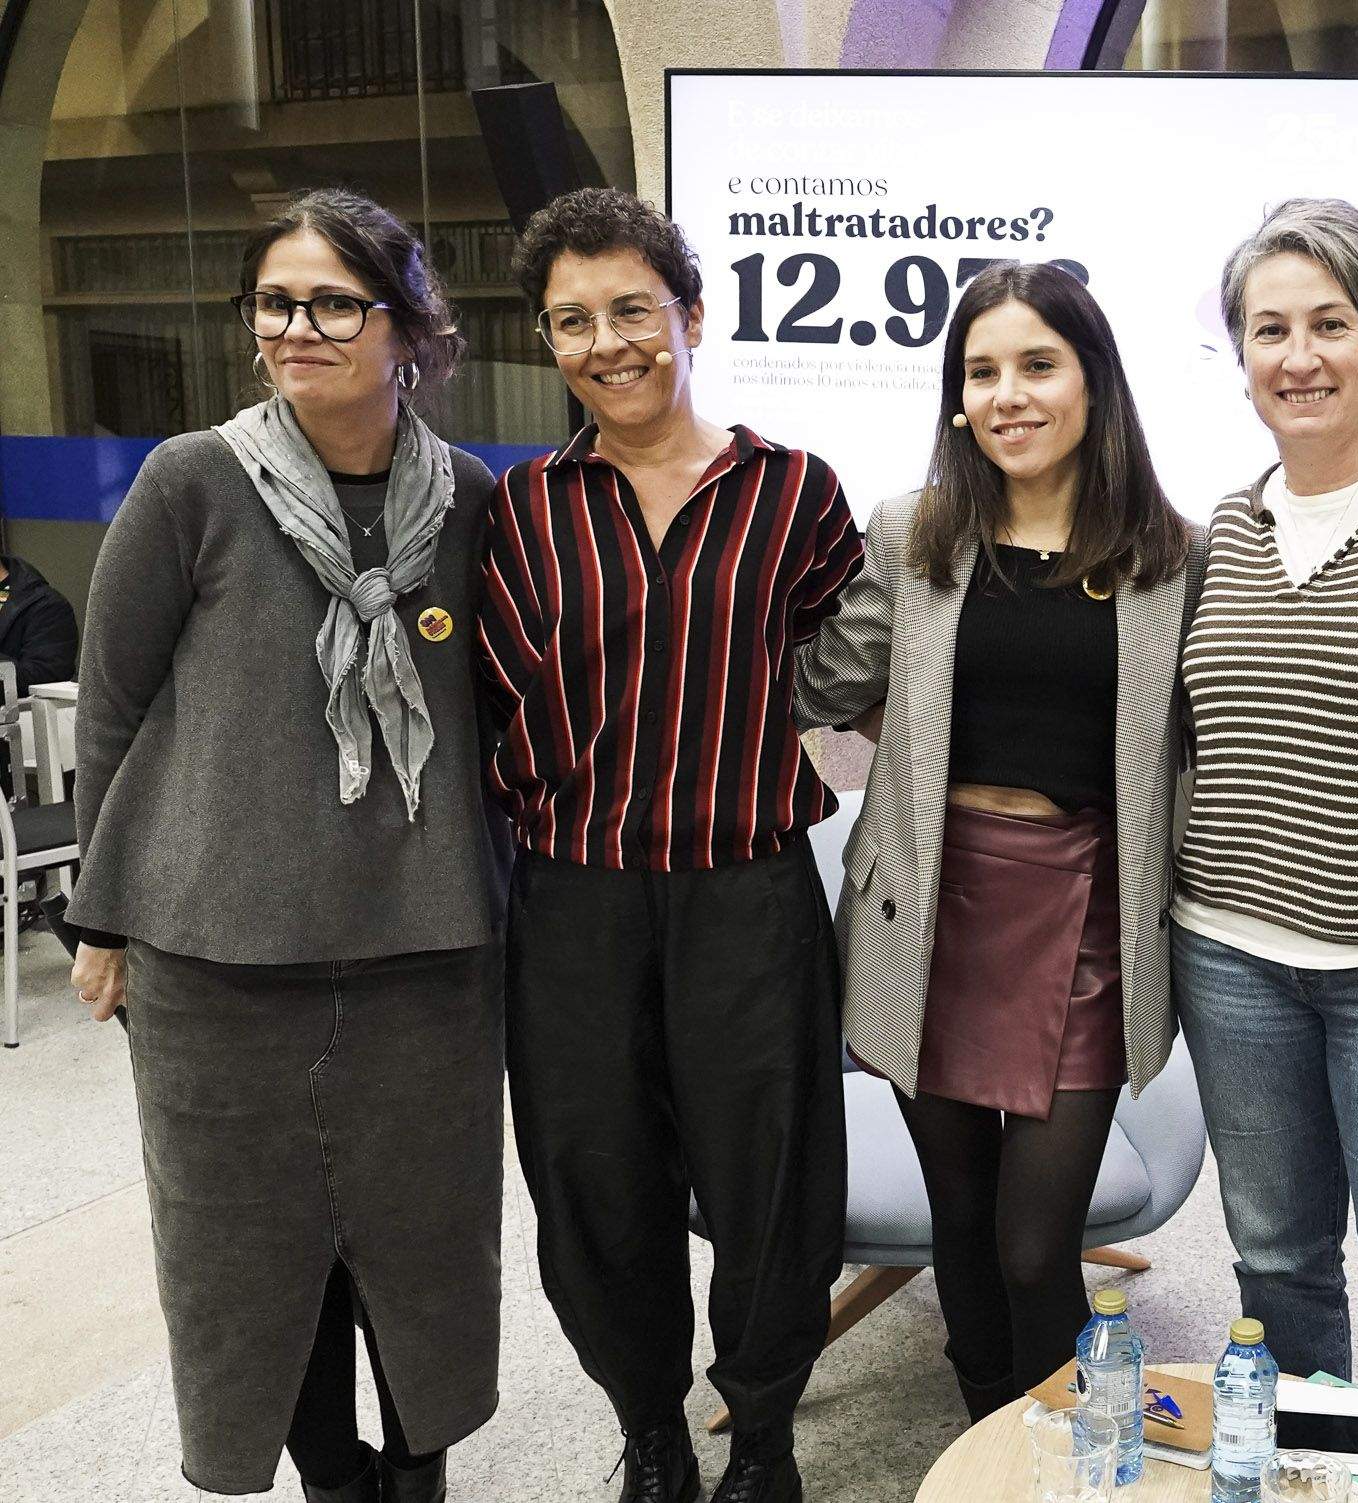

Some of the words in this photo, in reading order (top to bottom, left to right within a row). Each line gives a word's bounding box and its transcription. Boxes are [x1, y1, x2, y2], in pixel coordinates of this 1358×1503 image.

[728, 176, 742, 194] e
[750, 175, 888, 197] contamos
[728, 202, 1054, 241] maltratadores?
[730, 252, 1089, 348] 12.9
[732, 355, 817, 370] condenados
